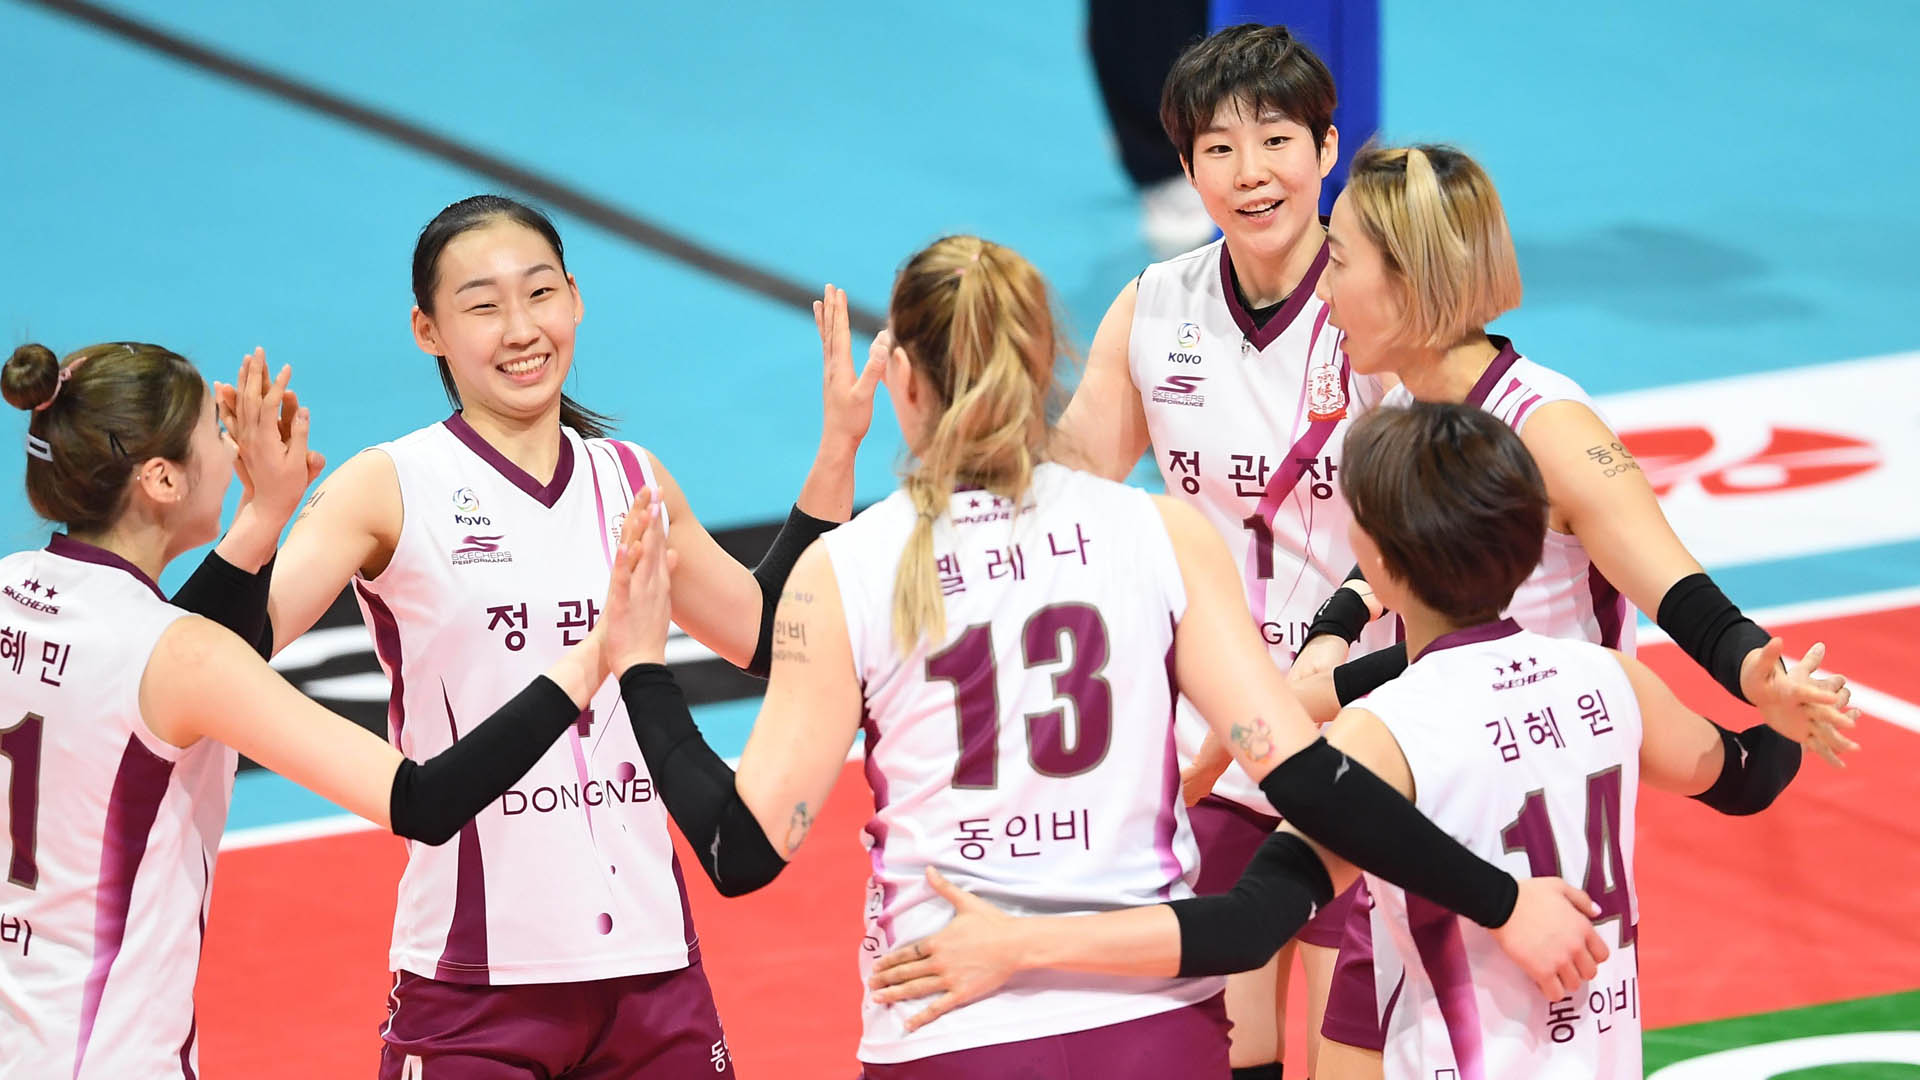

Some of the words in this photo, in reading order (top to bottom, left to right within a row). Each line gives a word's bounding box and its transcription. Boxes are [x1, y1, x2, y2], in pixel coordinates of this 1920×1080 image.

[1168, 352, 1202, 365] KOVO
[1168, 450, 1338, 500] 정관장
[454, 514, 491, 526] KOVO
[1243, 514, 1275, 580] 1
[2, 585, 60, 615] SKECHERS
[925, 601, 1113, 790] 13
[1492, 667, 1558, 691] SKECHERS
[1485, 689, 1614, 763] 김혜원
[502, 778, 657, 815] DONGNB
[954, 809, 1090, 861] 동인비
[1500, 764, 1636, 949] 14
